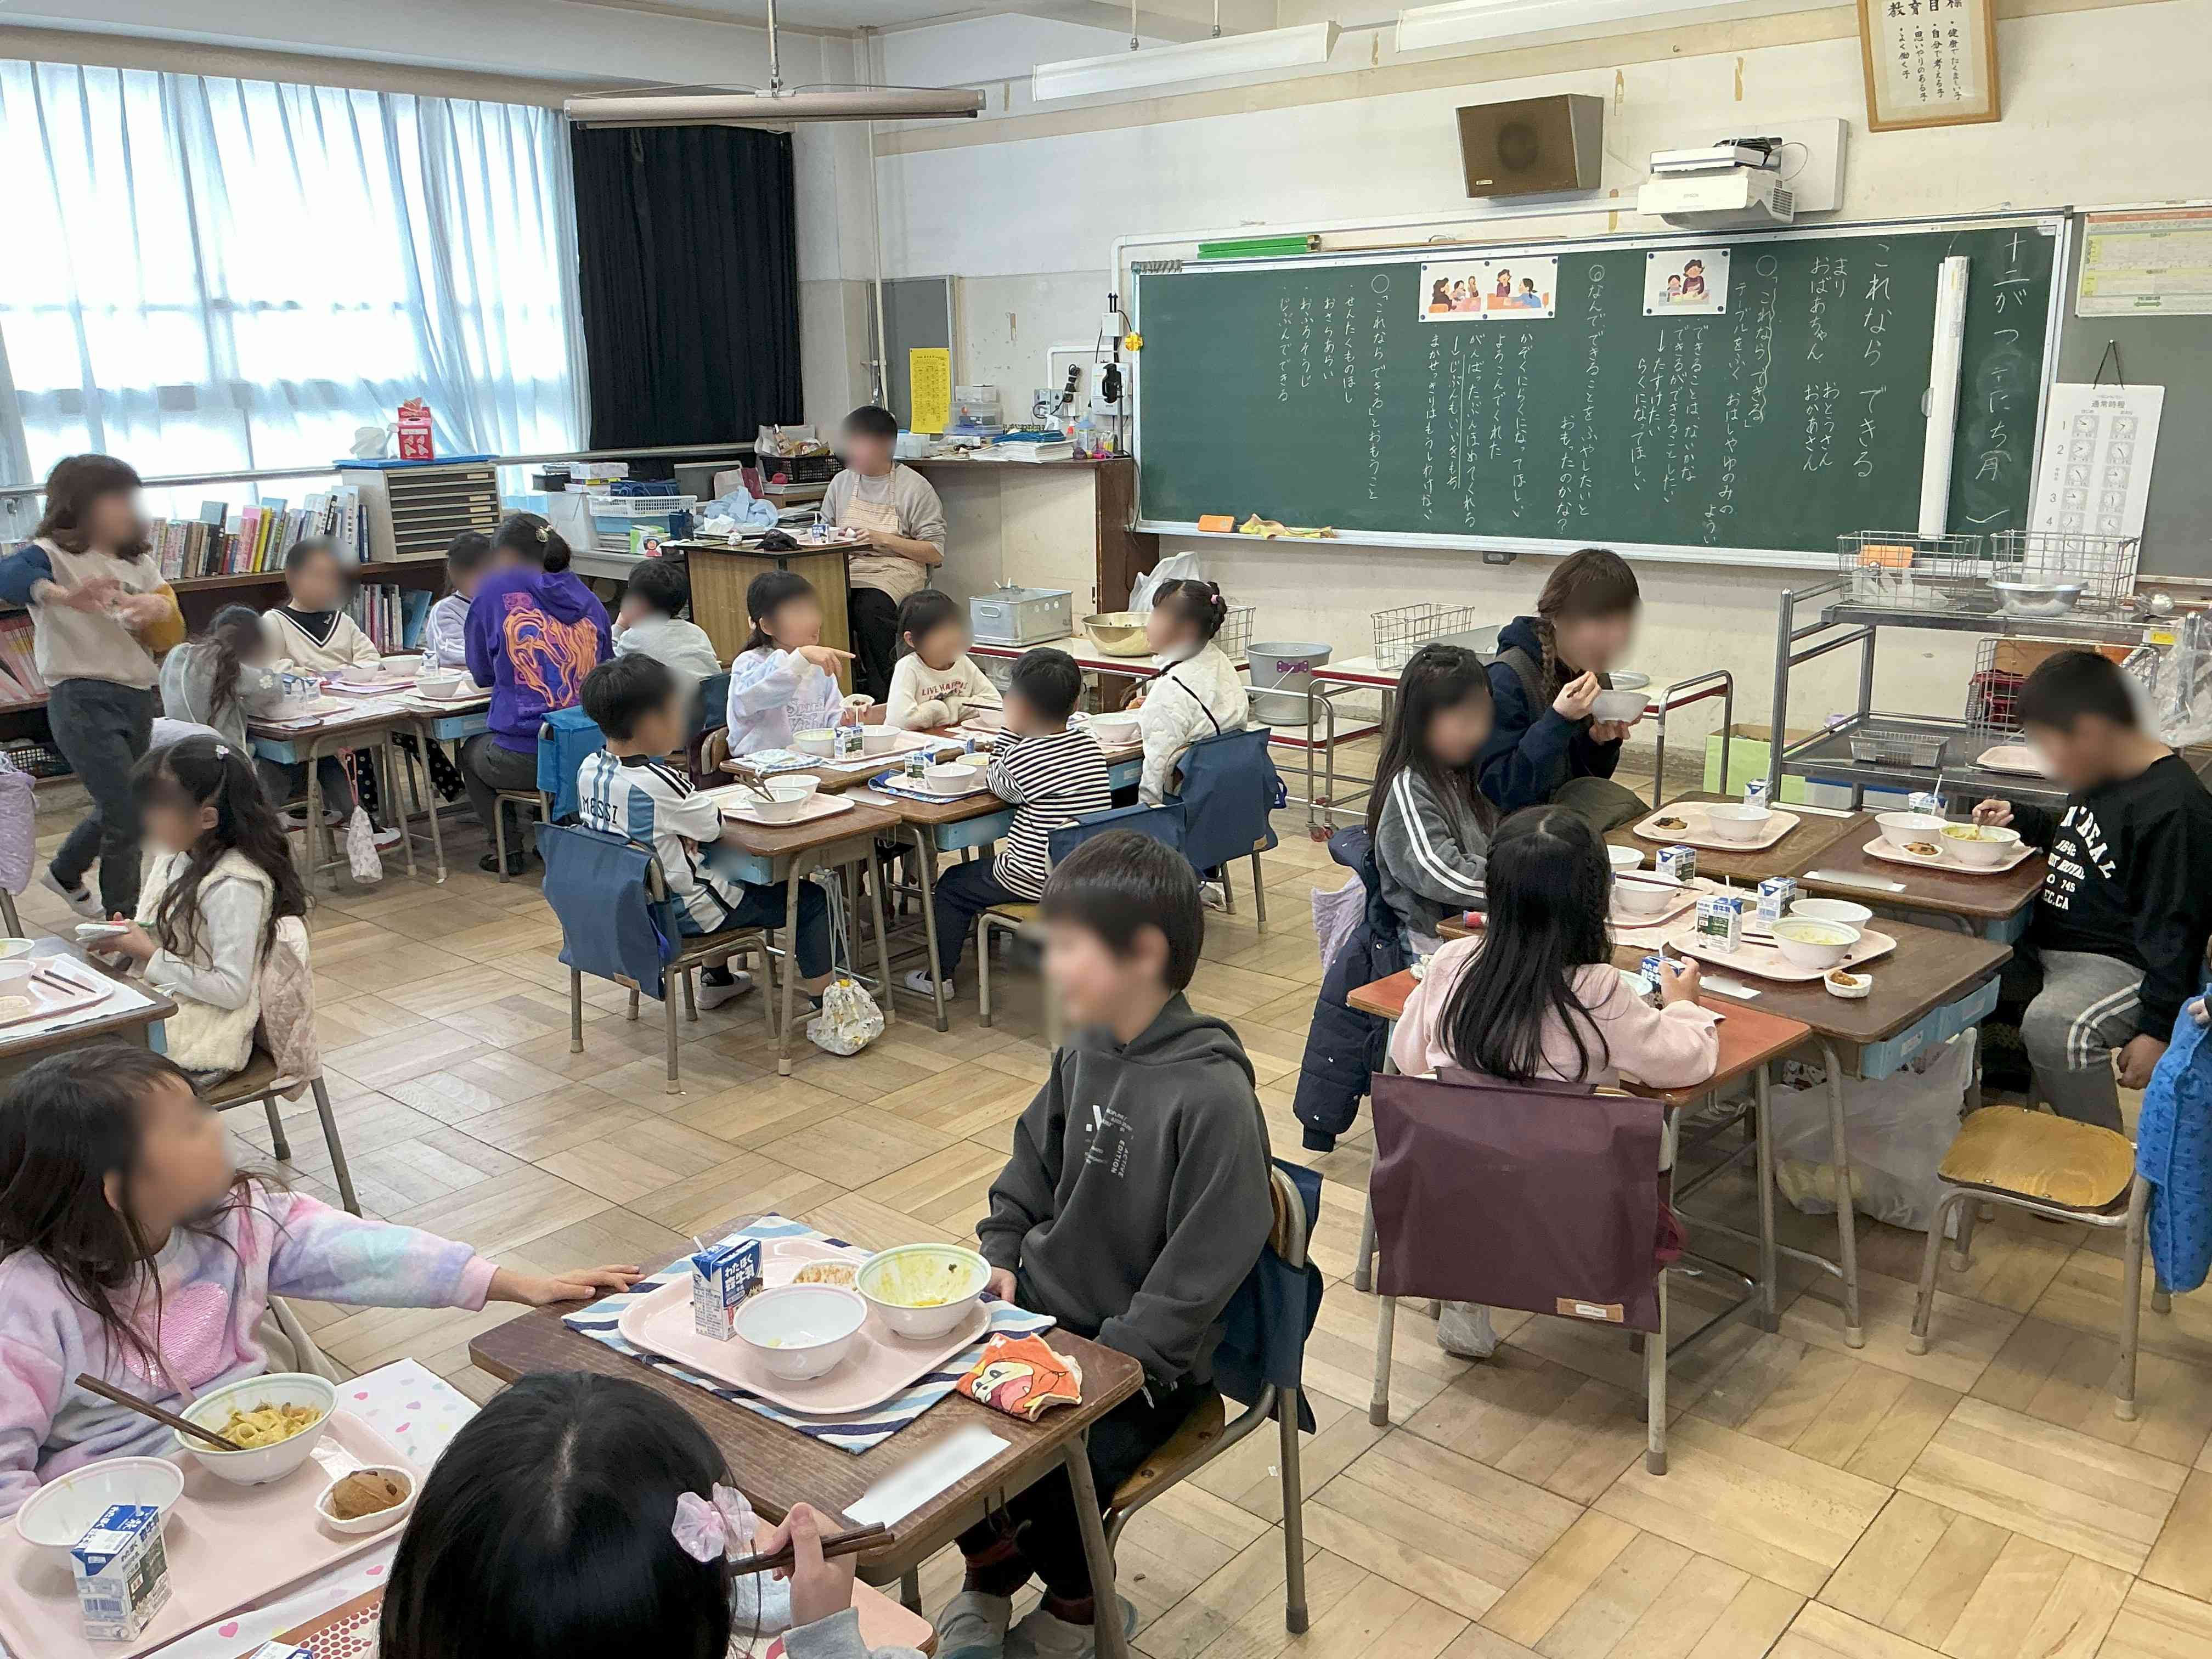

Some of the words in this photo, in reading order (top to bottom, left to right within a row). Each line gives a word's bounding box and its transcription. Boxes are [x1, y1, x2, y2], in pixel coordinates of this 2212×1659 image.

[1898, 33, 1910, 80] よく働く子
[1914, 31, 1929, 102] 思いやりのある子
[1931, 29, 1944, 98] 自分で考える子
[1806, 256, 1830, 361] おばあちゃん
[1833, 257, 1848, 297] まり
[1864, 243, 1892, 367] これなら
[1277, 298, 1294, 402] じぶんでできる
[1299, 298, 1314, 387] おふろそうじ
[1323, 297, 1336, 380] おさらあらい
[1342, 297, 1356, 404] せんたくものほし
[1728, 282, 1750, 380] テーブルをふく
[1489, 335, 1506, 459] よろこんでくれた
[1512, 333, 1533, 517] かぞくにらくになってほしい
[1630, 358, 1647, 491] らくになってほしい
[1649, 360, 1666, 437] たすけたい
[1802, 383, 1821, 471] おかあさん
[1818, 381, 1839, 466] おとうさん
[1853, 385, 1888, 477] できる
[2062, 421, 2066, 431] 1
[1718, 393, 1742, 514] おはしやゆのみの
[2057, 445, 2064, 454] 2
[1703, 504, 1718, 543] ようい
[2046, 517, 2052, 526] 4
[2050, 493, 2057, 503] 3
[922, 686, 939, 696] LIVE
[582, 795, 618, 825] MESSI
[1110, 1139, 1125, 1173] EDITION
[1118, 1147, 1128, 1178] ACTIVE
[725, 1253, 753, 1278] わたぼく
